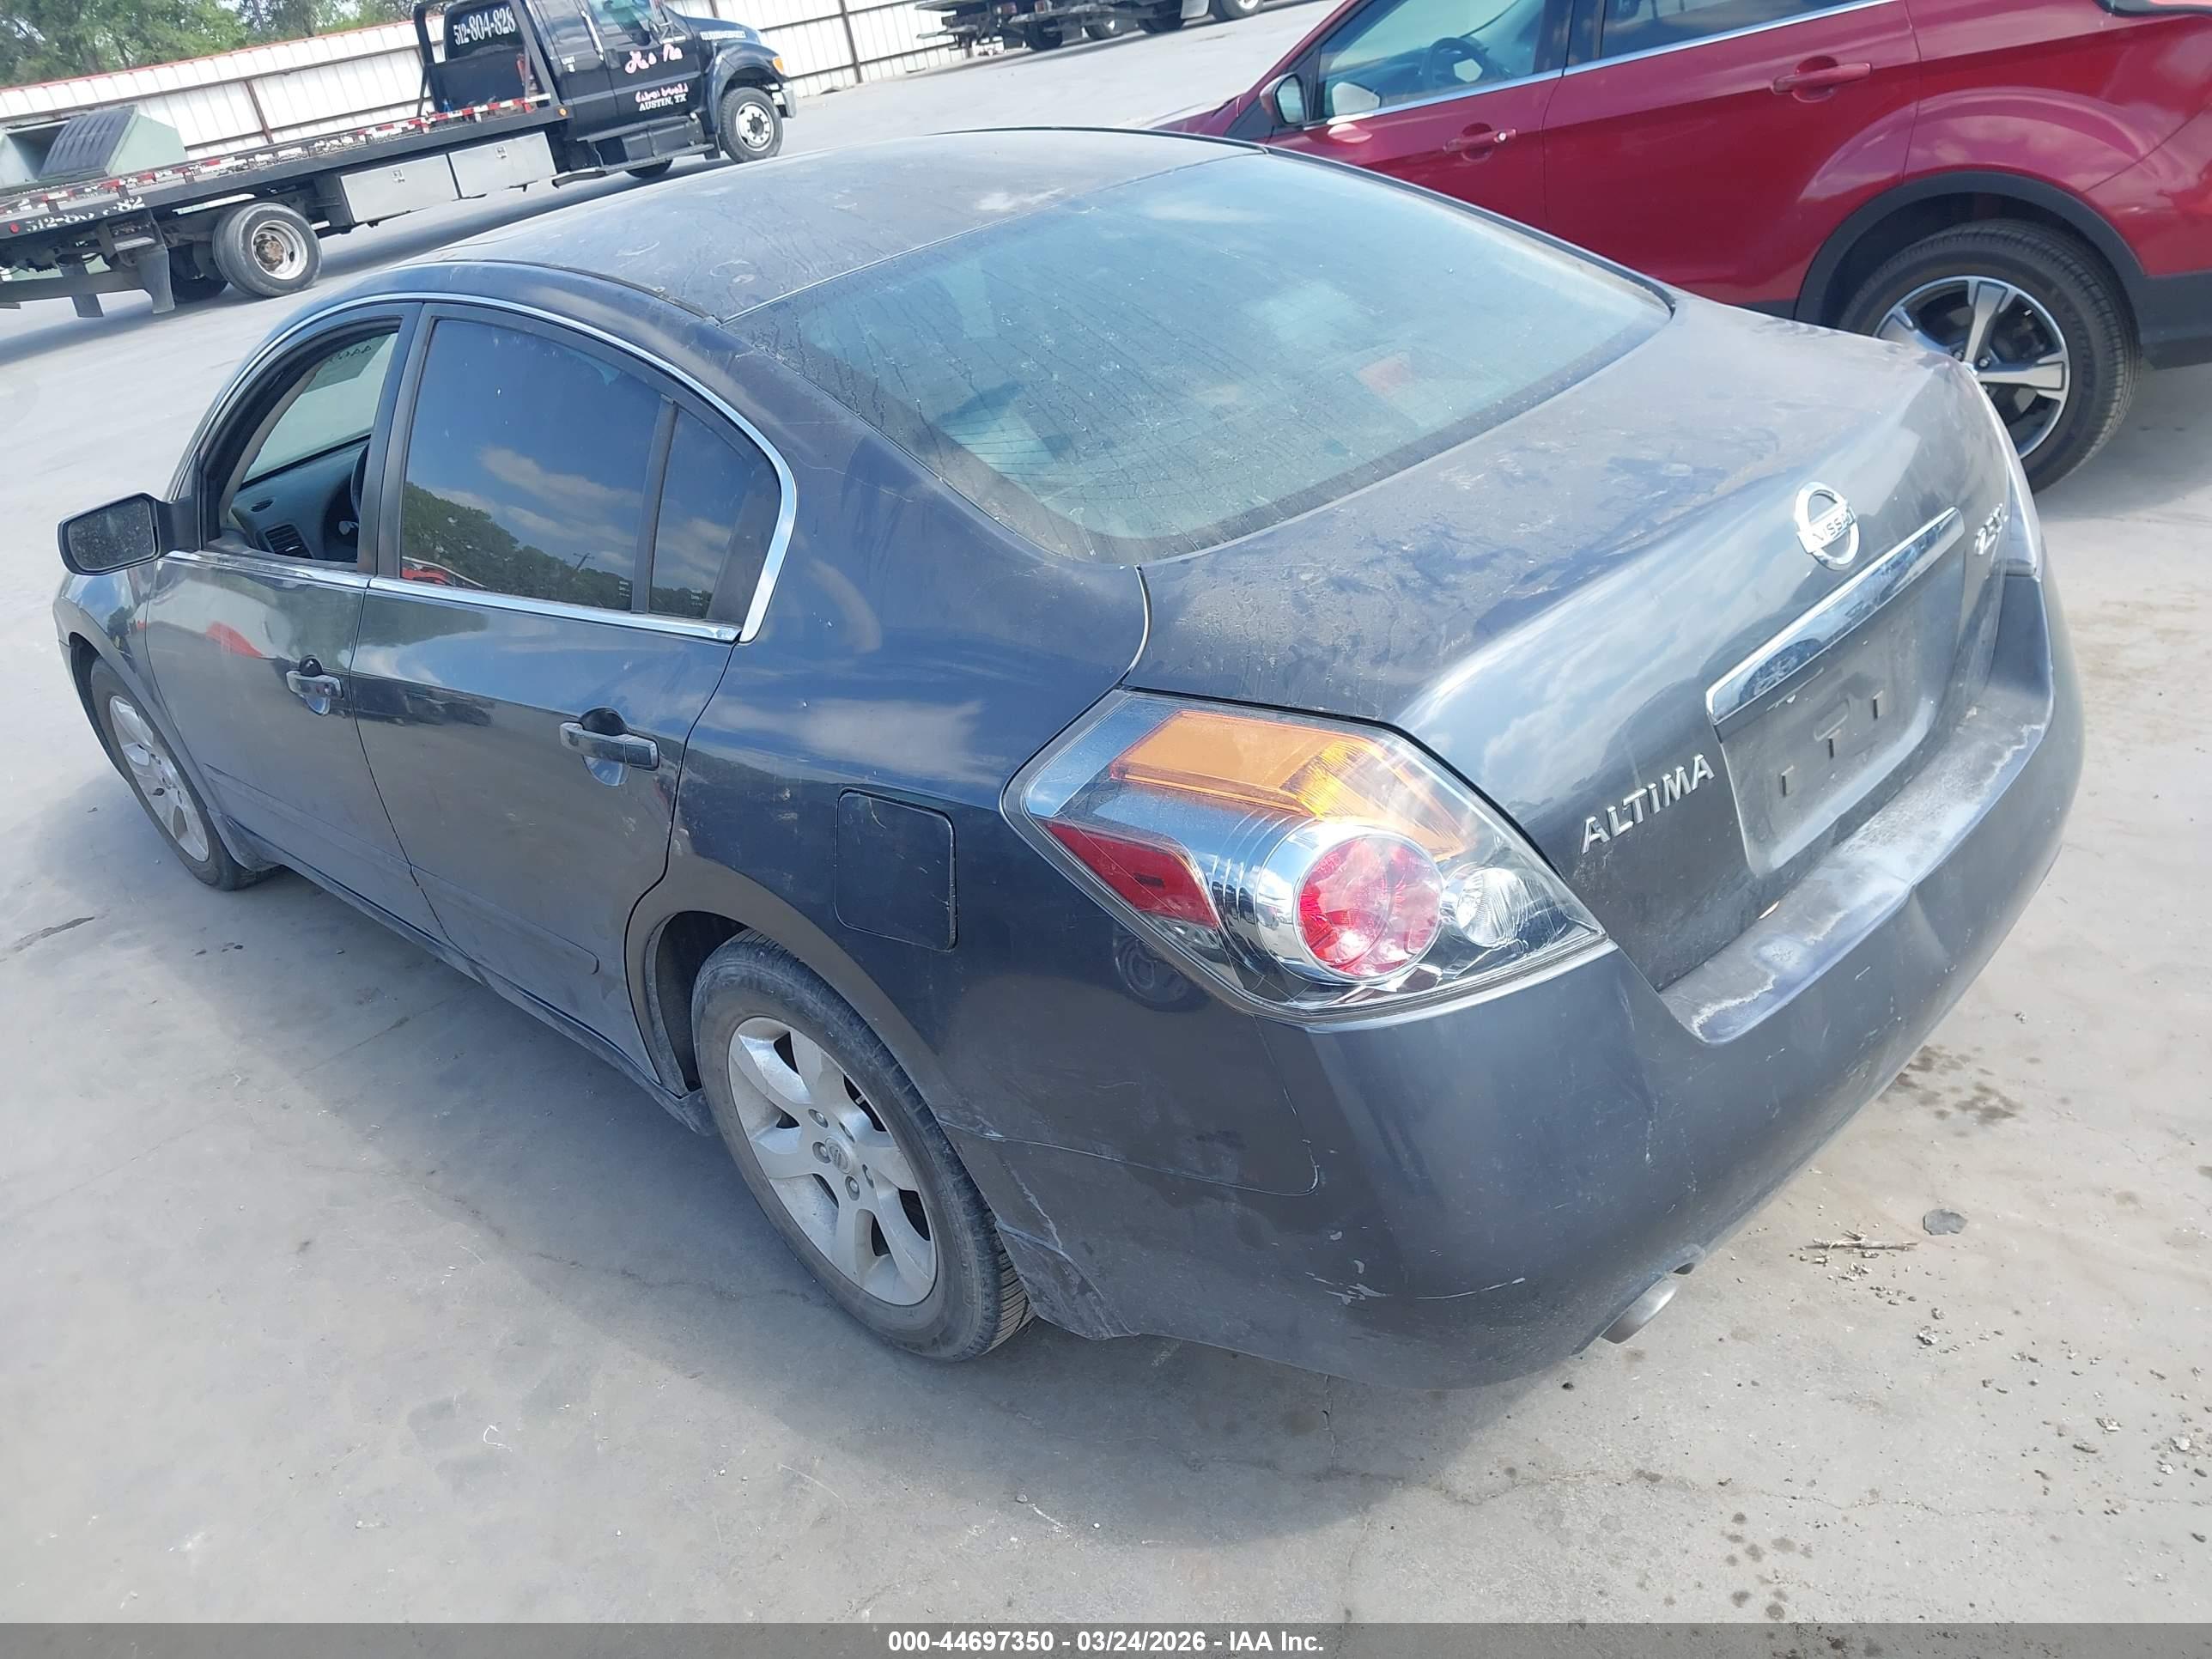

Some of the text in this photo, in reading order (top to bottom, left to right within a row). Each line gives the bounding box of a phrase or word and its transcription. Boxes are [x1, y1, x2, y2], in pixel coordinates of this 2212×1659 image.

[638, 95, 674, 112] AUSTIN,
[674, 93, 687, 104] TX
[1580, 752, 1716, 856] ALTIMA
